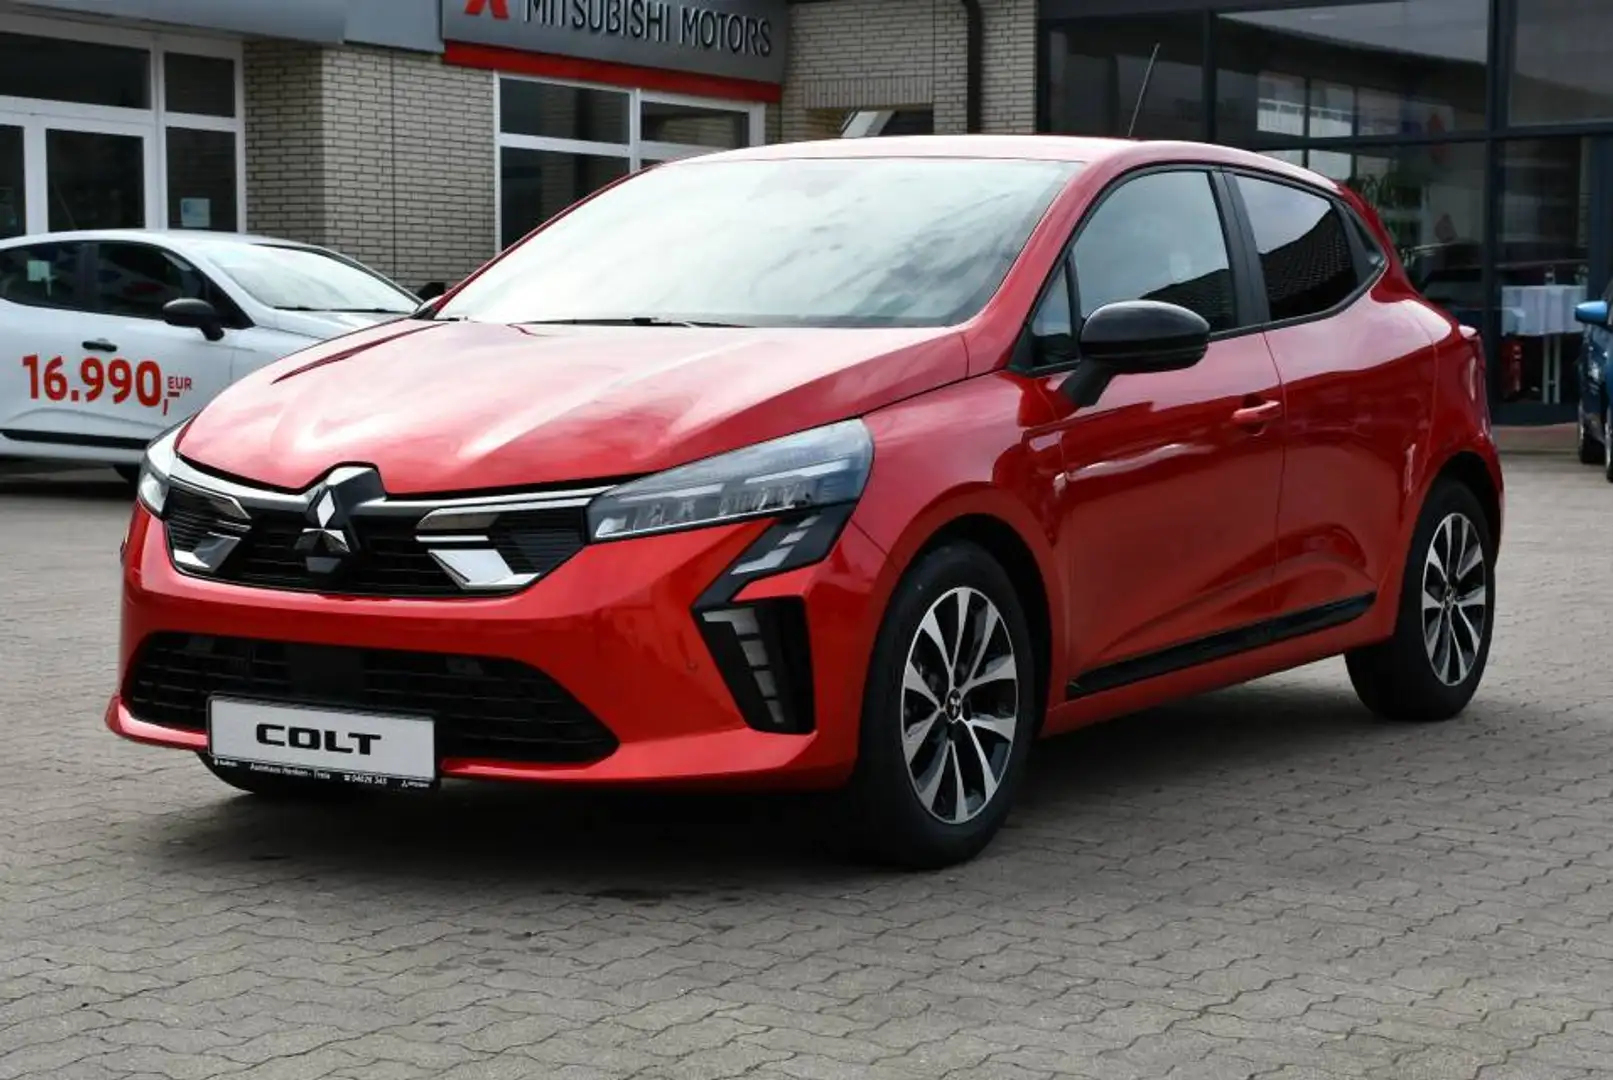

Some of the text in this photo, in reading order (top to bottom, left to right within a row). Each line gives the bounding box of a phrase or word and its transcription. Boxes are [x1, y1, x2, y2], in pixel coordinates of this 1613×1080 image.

[524, 0, 772, 57] MITSUBISHI MOTORS
[167, 376, 193, 391] EUR
[256, 723, 382, 756] COLT
